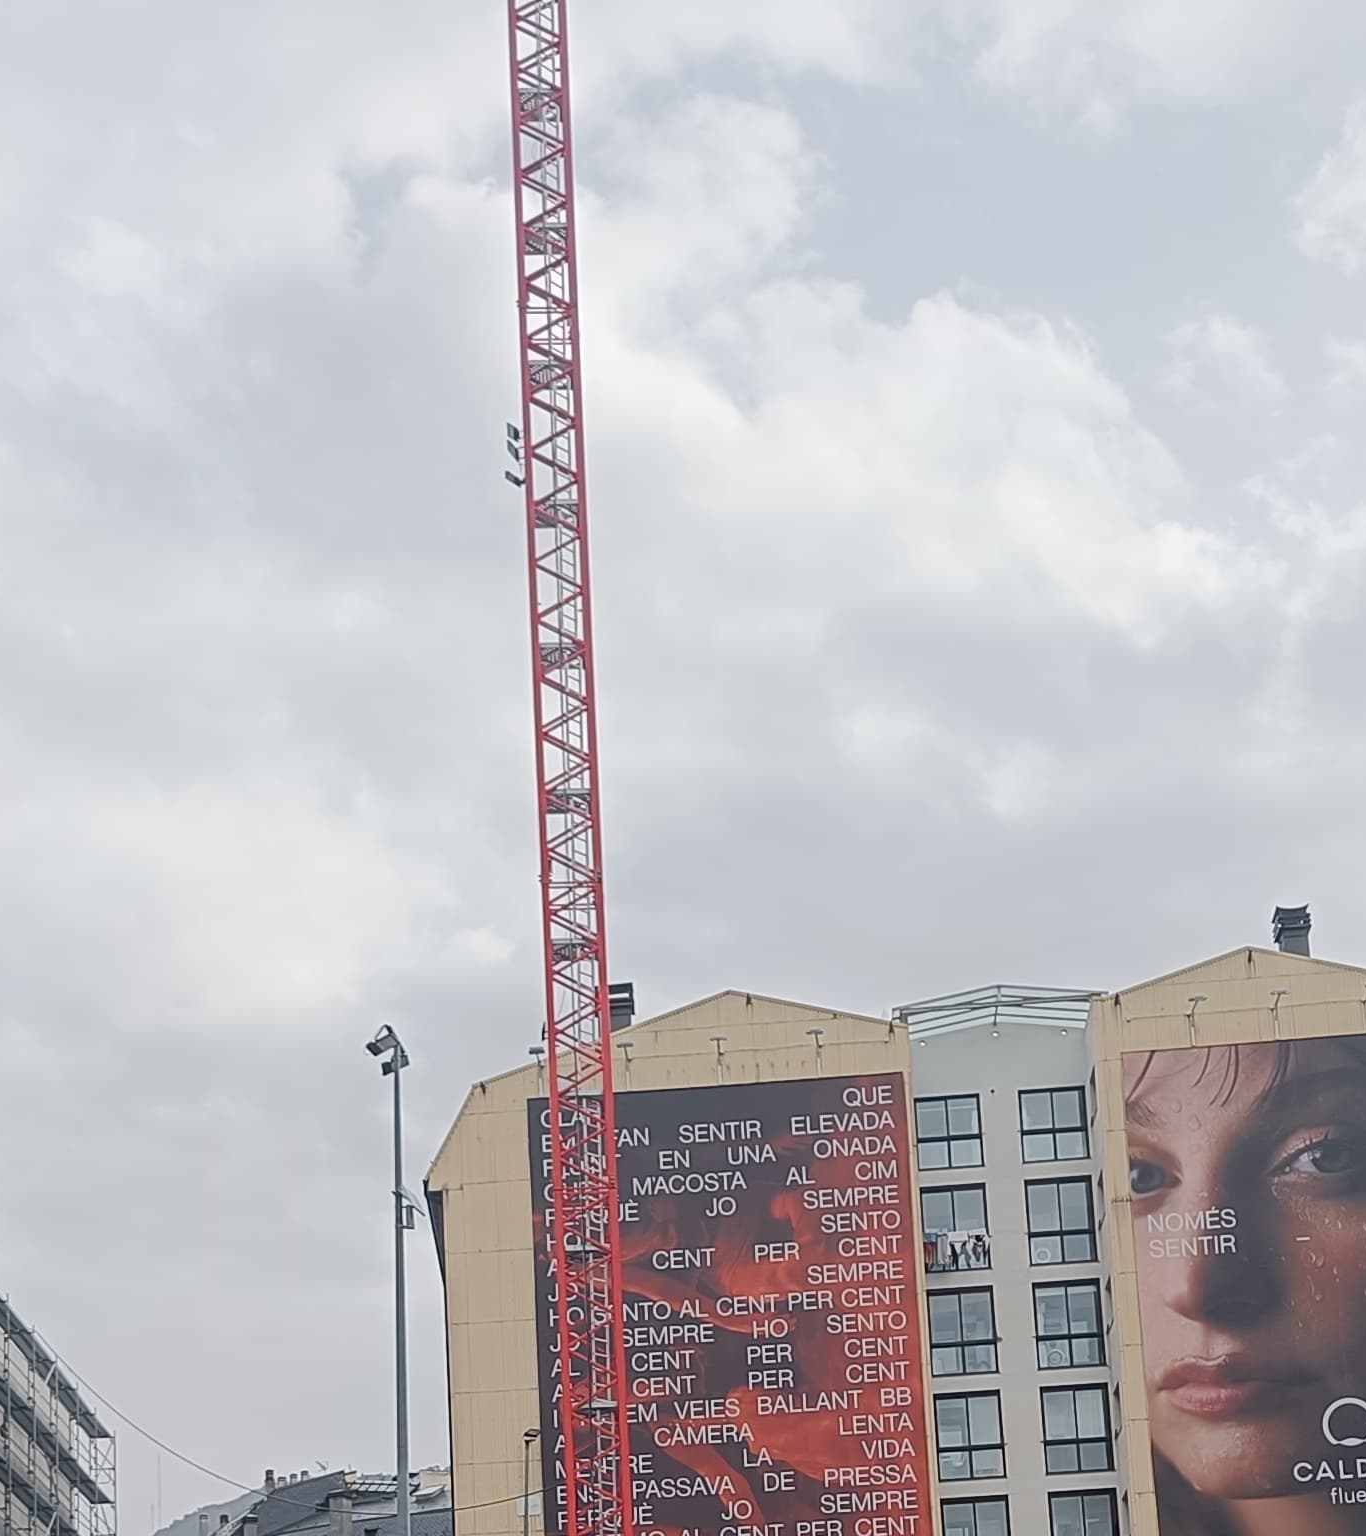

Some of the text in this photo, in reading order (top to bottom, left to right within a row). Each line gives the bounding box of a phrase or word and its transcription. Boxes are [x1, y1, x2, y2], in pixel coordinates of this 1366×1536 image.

[842, 1085, 893, 1107] QUE
[678, 1120, 762, 1144] SENTIR
[790, 1110, 895, 1136] ELEVADA
[658, 1135, 897, 1170] EN UNA ONADA
[632, 1171, 747, 1196] M'ACOSTA
[786, 1165, 815, 1186] AL
[855, 1159, 898, 1181] CIM
[705, 1196, 737, 1217] JO
[803, 1185, 900, 1209] SEMPRE
[821, 1209, 901, 1233] SENTO
[1147, 1206, 1237, 1233] NOMÉS
[652, 1248, 716, 1270] CENT
[754, 1242, 800, 1263] PER
[838, 1234, 902, 1257] CENT
[1148, 1234, 1237, 1259] SENTIR
[807, 1260, 904, 1285] SEMPRE
[679, 1299, 710, 1319] AL
[716, 1294, 780, 1317] CENT
[787, 1290, 834, 1312] PER
[841, 1285, 905, 1307] CENT
[621, 1323, 715, 1348] SEMPRE
[752, 1318, 788, 1339] HO
[826, 1310, 907, 1334] SENTO
[631, 1350, 695, 1372] CENT
[747, 1343, 793, 1365] PER
[844, 1335, 908, 1358] CENT
[632, 1375, 696, 1397] CENT
[748, 1368, 794, 1390] PER
[845, 1360, 909, 1384] CENT
[626, 1402, 658, 1423] EM
[674, 1399, 741, 1421] VEIES
[757, 1389, 863, 1416] BALLANT
[880, 1386, 912, 1408] BB
[654, 1423, 754, 1448] CÀMERA
[838, 1412, 914, 1436] LENTA
[742, 1447, 773, 1468] LA
[861, 1438, 916, 1460] VIDA
[632, 1475, 736, 1500] PASSAVA
[763, 1471, 796, 1493] DE
[824, 1464, 918, 1488] PRESSA
[721, 1499, 753, 1521] JO
[820, 1489, 919, 1515] SEMPRE
